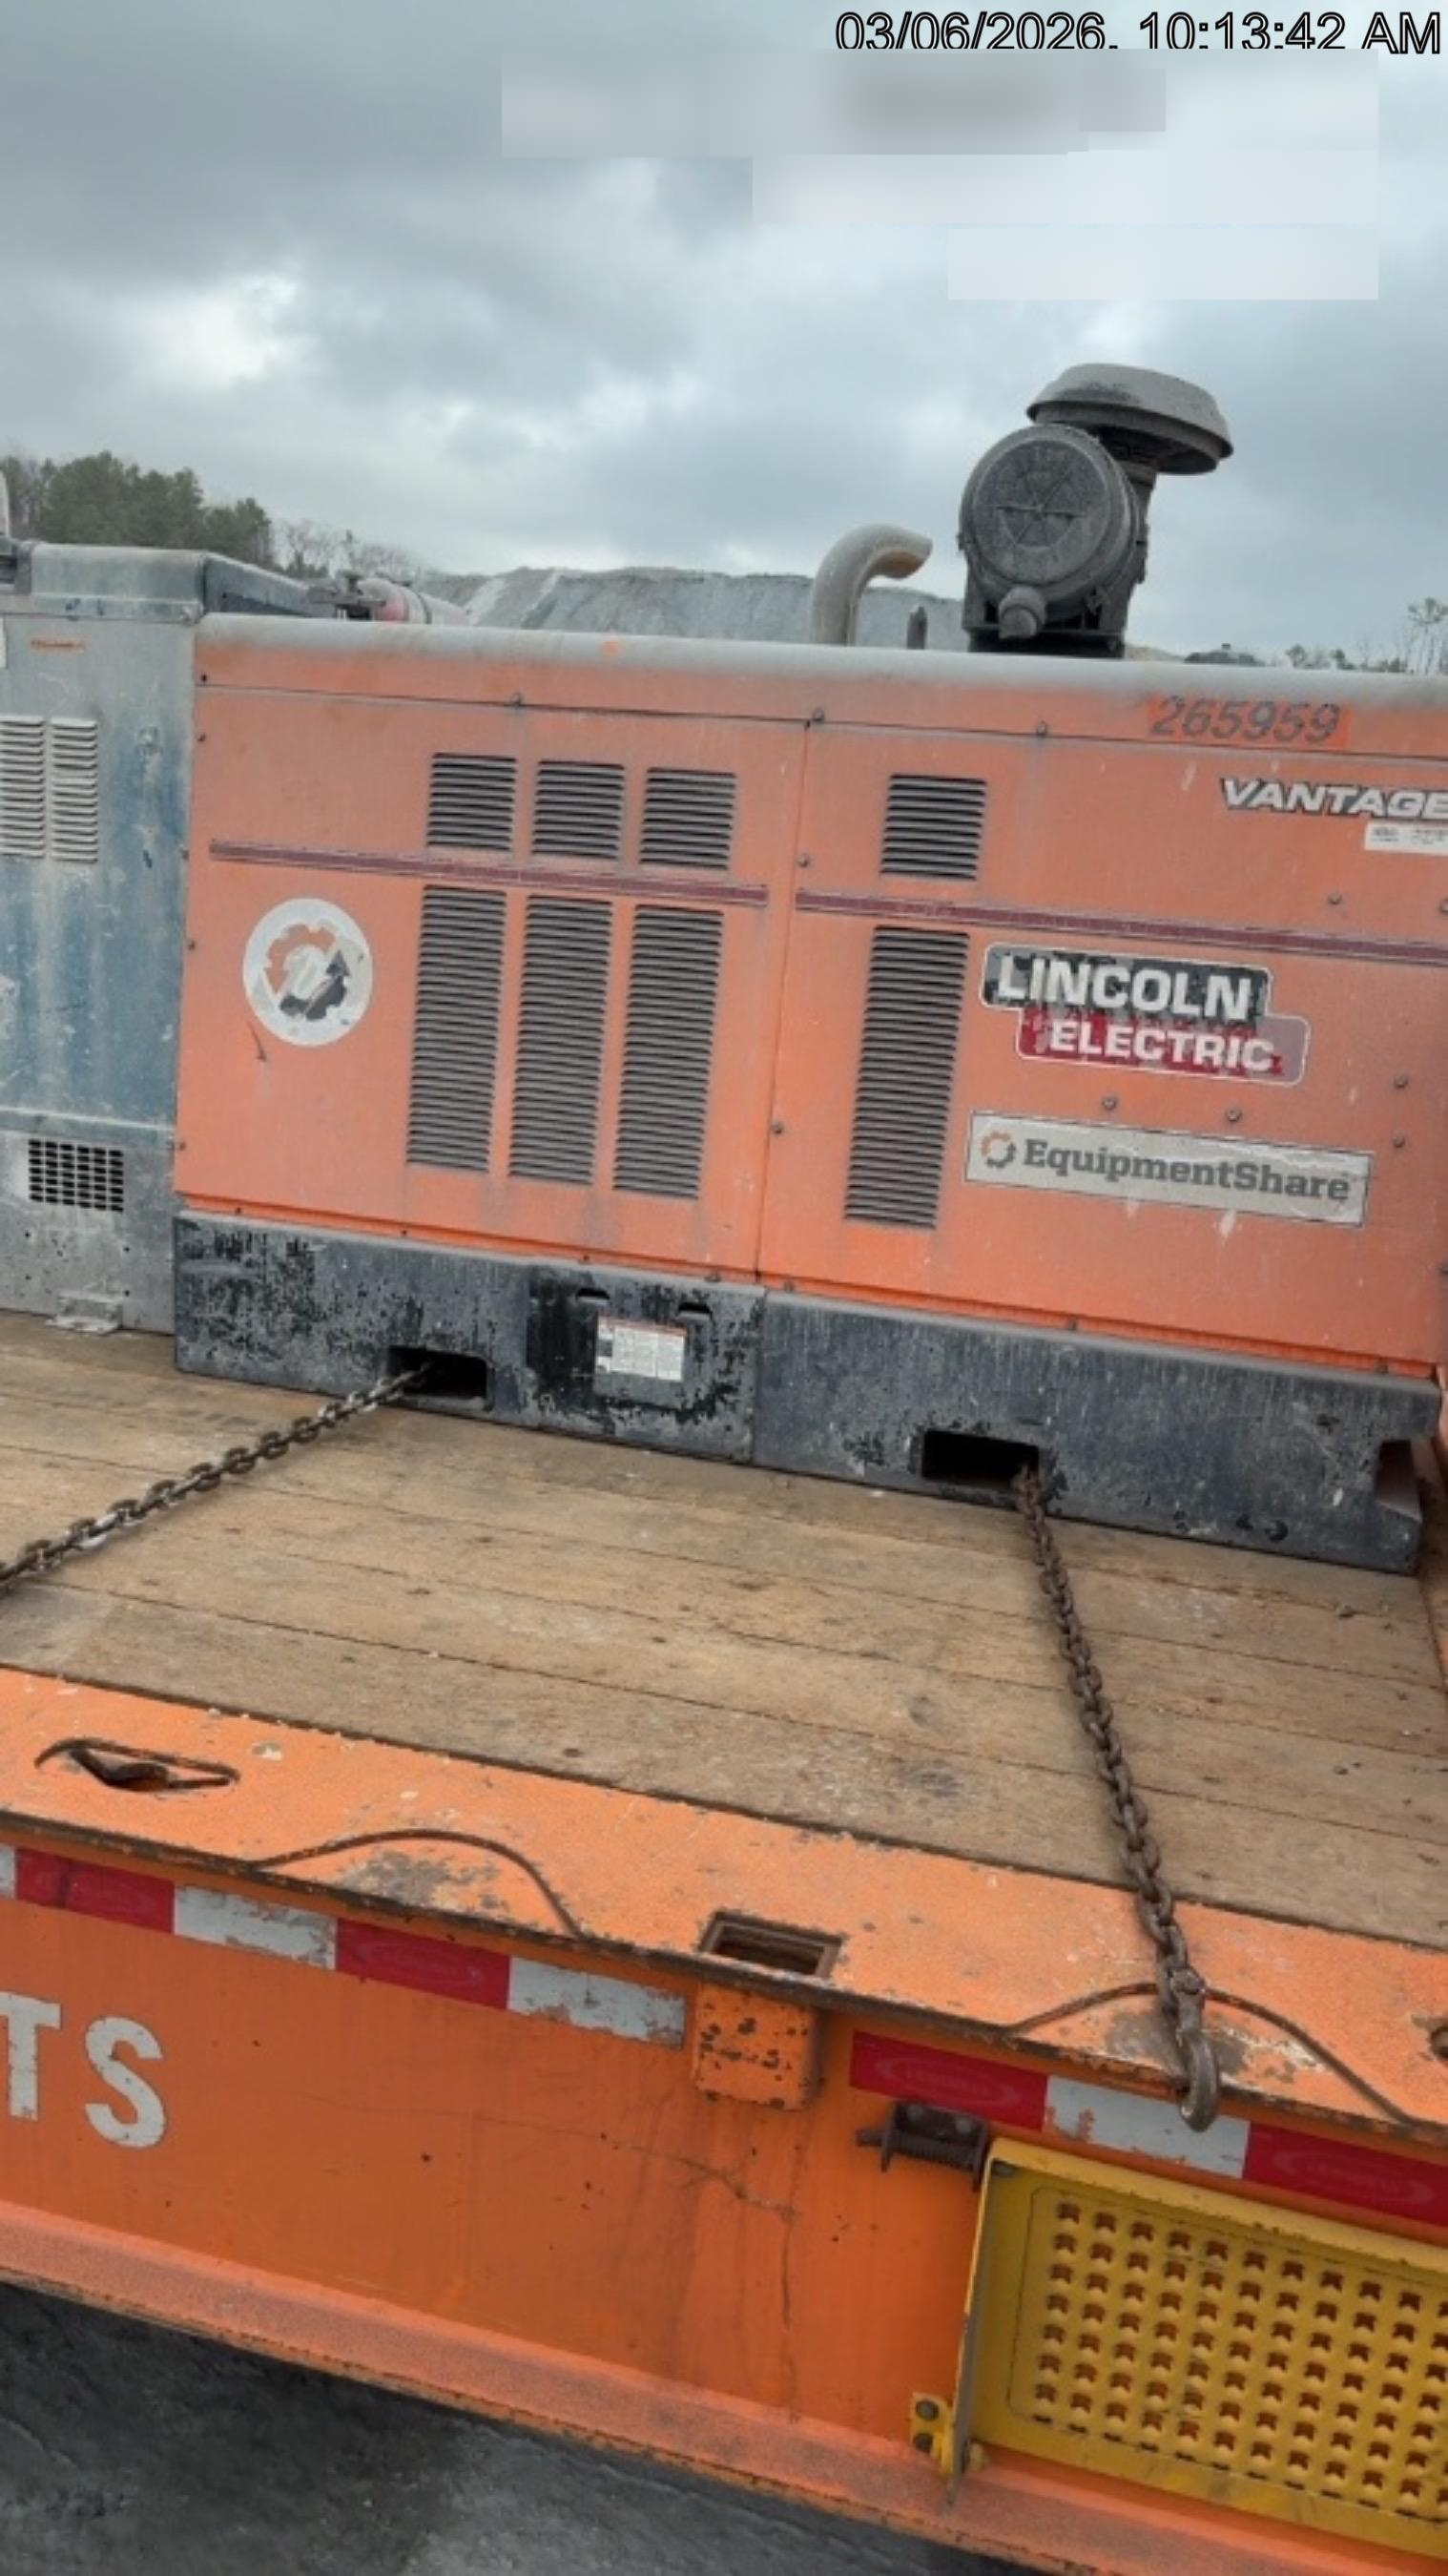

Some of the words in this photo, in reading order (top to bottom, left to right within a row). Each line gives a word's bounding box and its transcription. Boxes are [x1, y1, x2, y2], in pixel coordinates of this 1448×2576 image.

[1150, 695, 1339, 742] 265959
[1221, 778, 1448, 819] VANTAGE
[998, 955, 1251, 1020] LINCOLN
[1050, 1021, 1273, 1071] ELECTRIC
[1024, 1139, 1350, 1202] EquipmentShare
